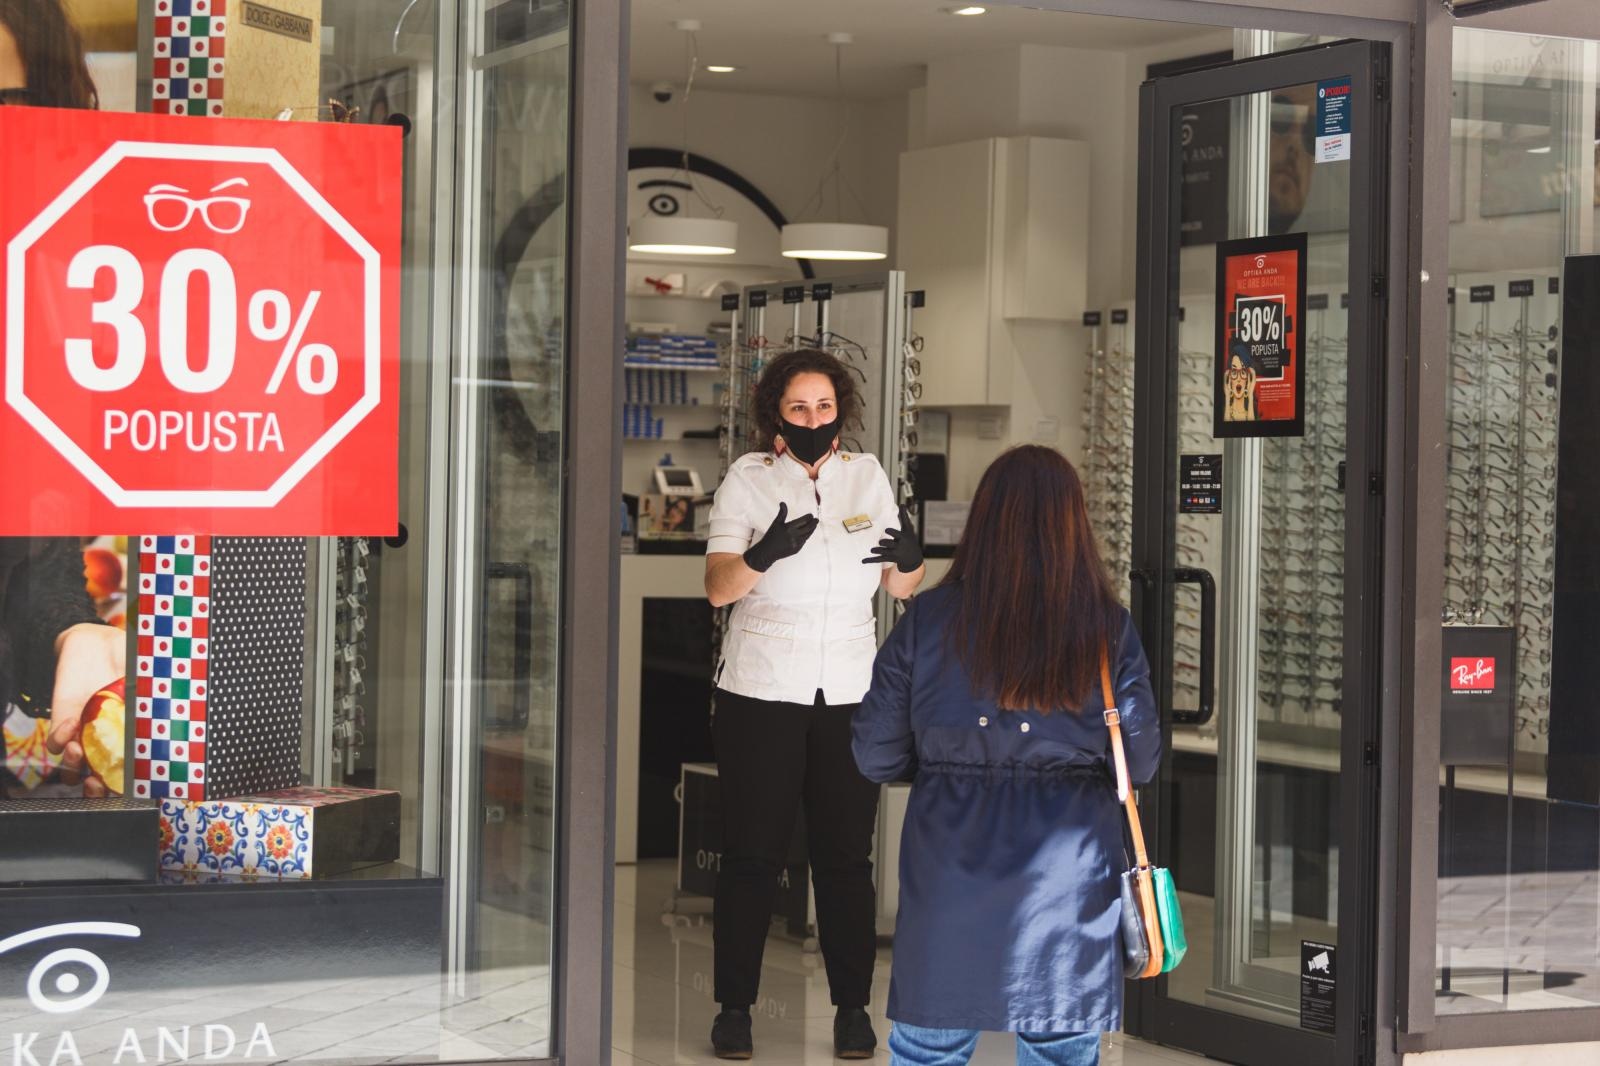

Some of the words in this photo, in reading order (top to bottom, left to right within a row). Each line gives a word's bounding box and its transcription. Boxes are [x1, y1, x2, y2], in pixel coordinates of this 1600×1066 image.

[64, 244, 339, 395] 30%
[1241, 305, 1280, 343] 30%
[1251, 343, 1279, 357] POPUSTA
[103, 409, 285, 453] POPUSTA
[696, 849, 722, 873] OPT
[112, 1022, 278, 1066] ANDA
